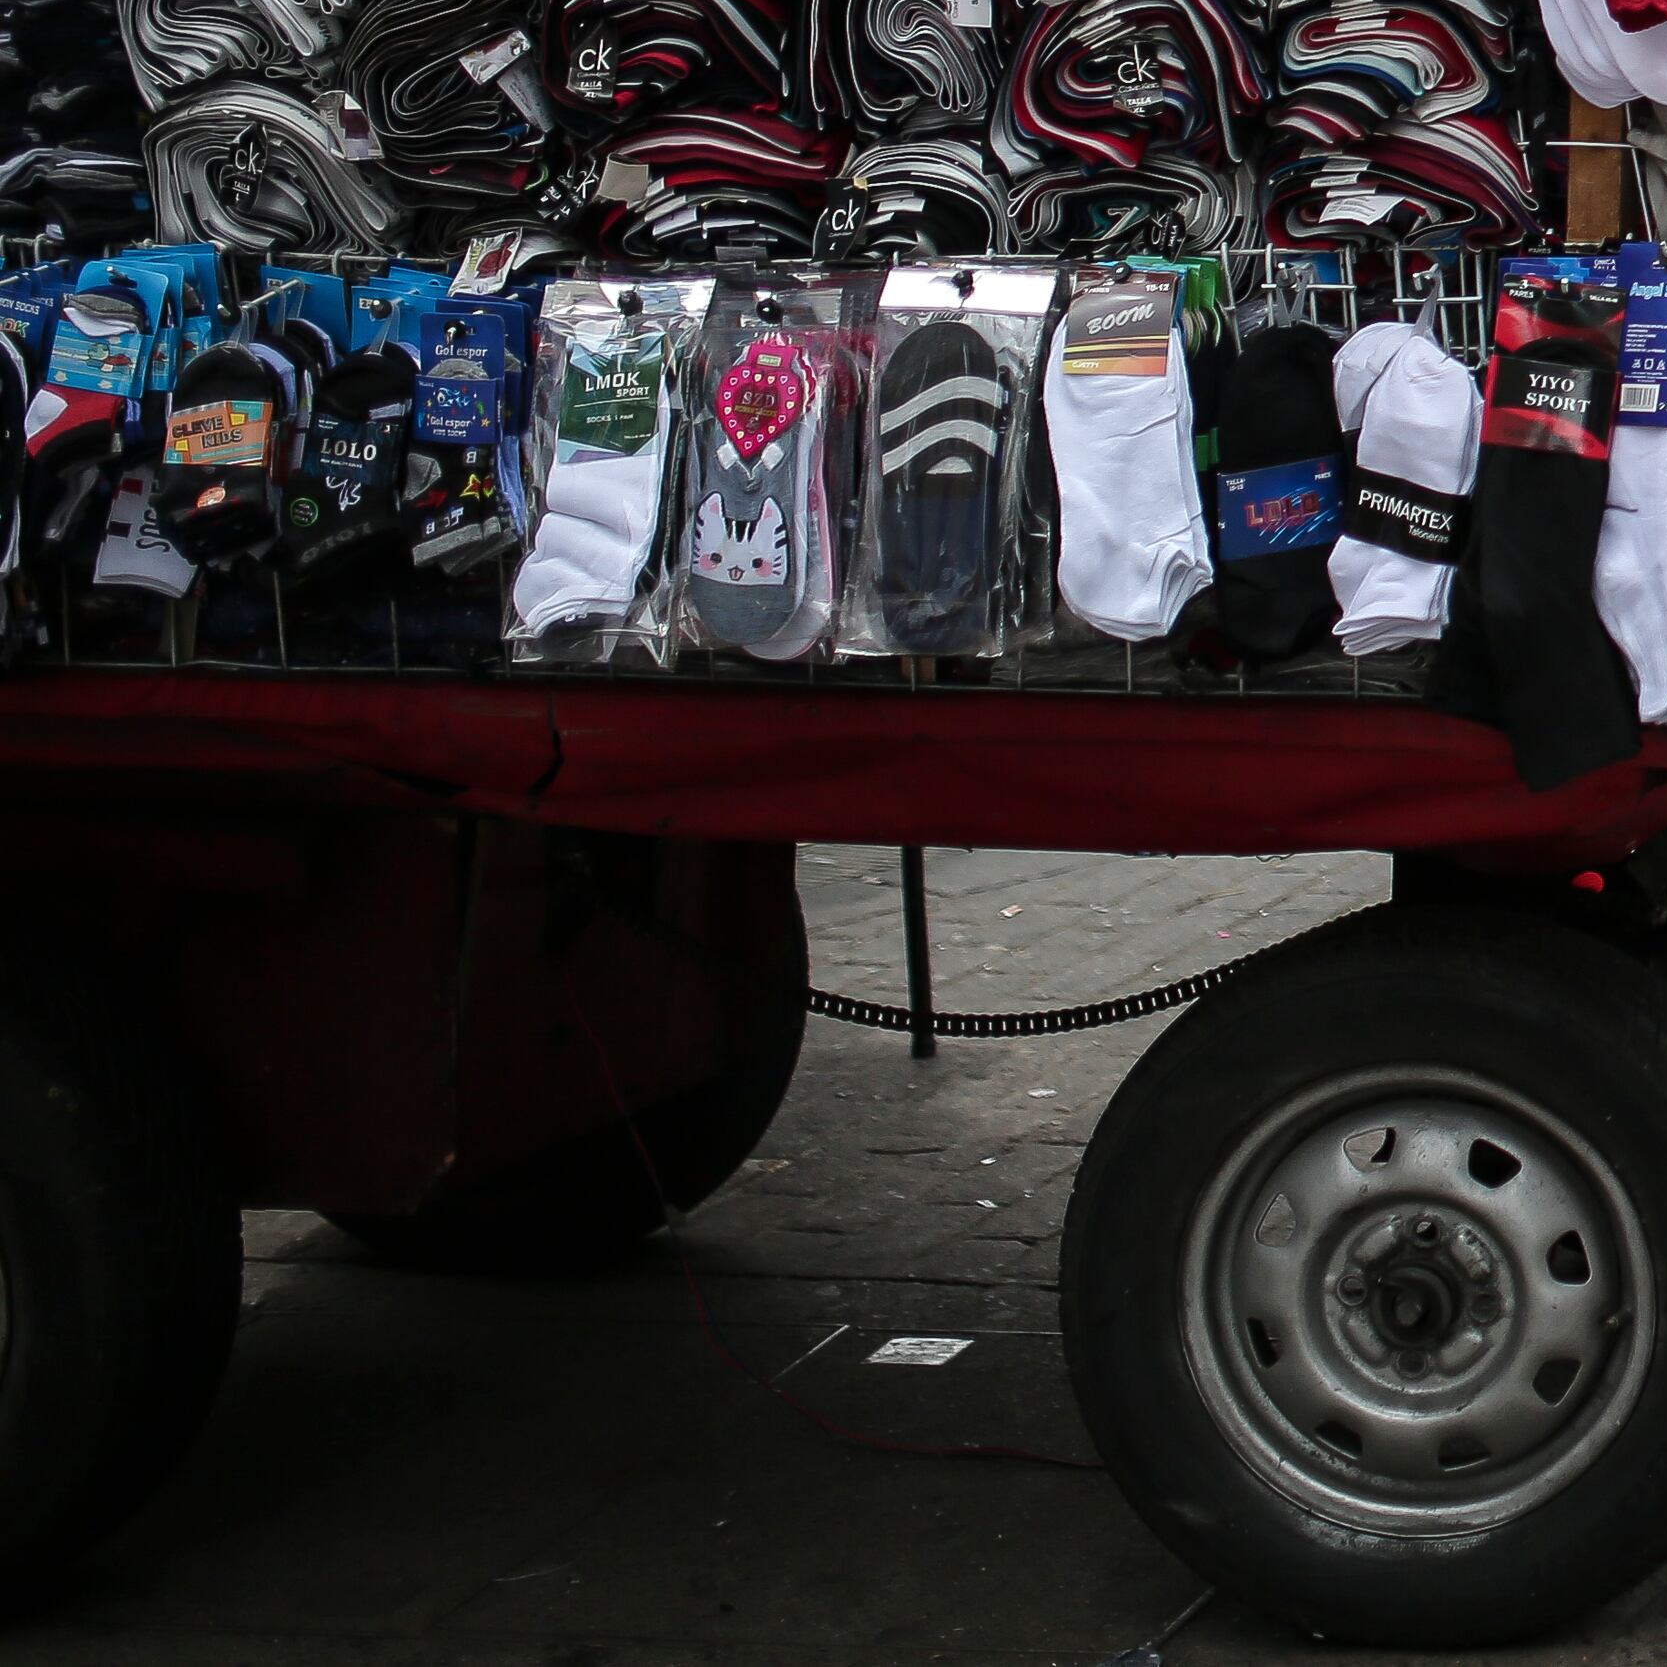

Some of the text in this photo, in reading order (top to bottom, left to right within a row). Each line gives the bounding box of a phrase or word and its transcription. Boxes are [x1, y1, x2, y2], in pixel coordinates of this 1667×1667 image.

[578, 38, 613, 72] ck
[1117, 43, 1156, 84] ck
[580, 80, 603, 88] TALLA
[1126, 96, 1152, 106] TALLA
[234, 141, 260, 175] ck
[831, 199, 857, 232] ck
[1508, 289, 1534, 299] PARES
[1519, 278, 1529, 290] 3
[1629, 282, 1664, 301] Angel
[0, 317, 30, 338] OK
[1085, 302, 1156, 335] BOOM
[435, 344, 488, 360] Gol espor
[585, 371, 641, 393] LMOK
[616, 386, 650, 398] SPORT
[1528, 372, 1575, 393] YIYO
[1523, 392, 1592, 414] SPORT
[587, 414, 612, 424] SOCKS
[201, 428, 243, 448] KIDS
[319, 437, 378, 462] LOLO
[1357, 488, 1455, 532] PRIMARTEX
